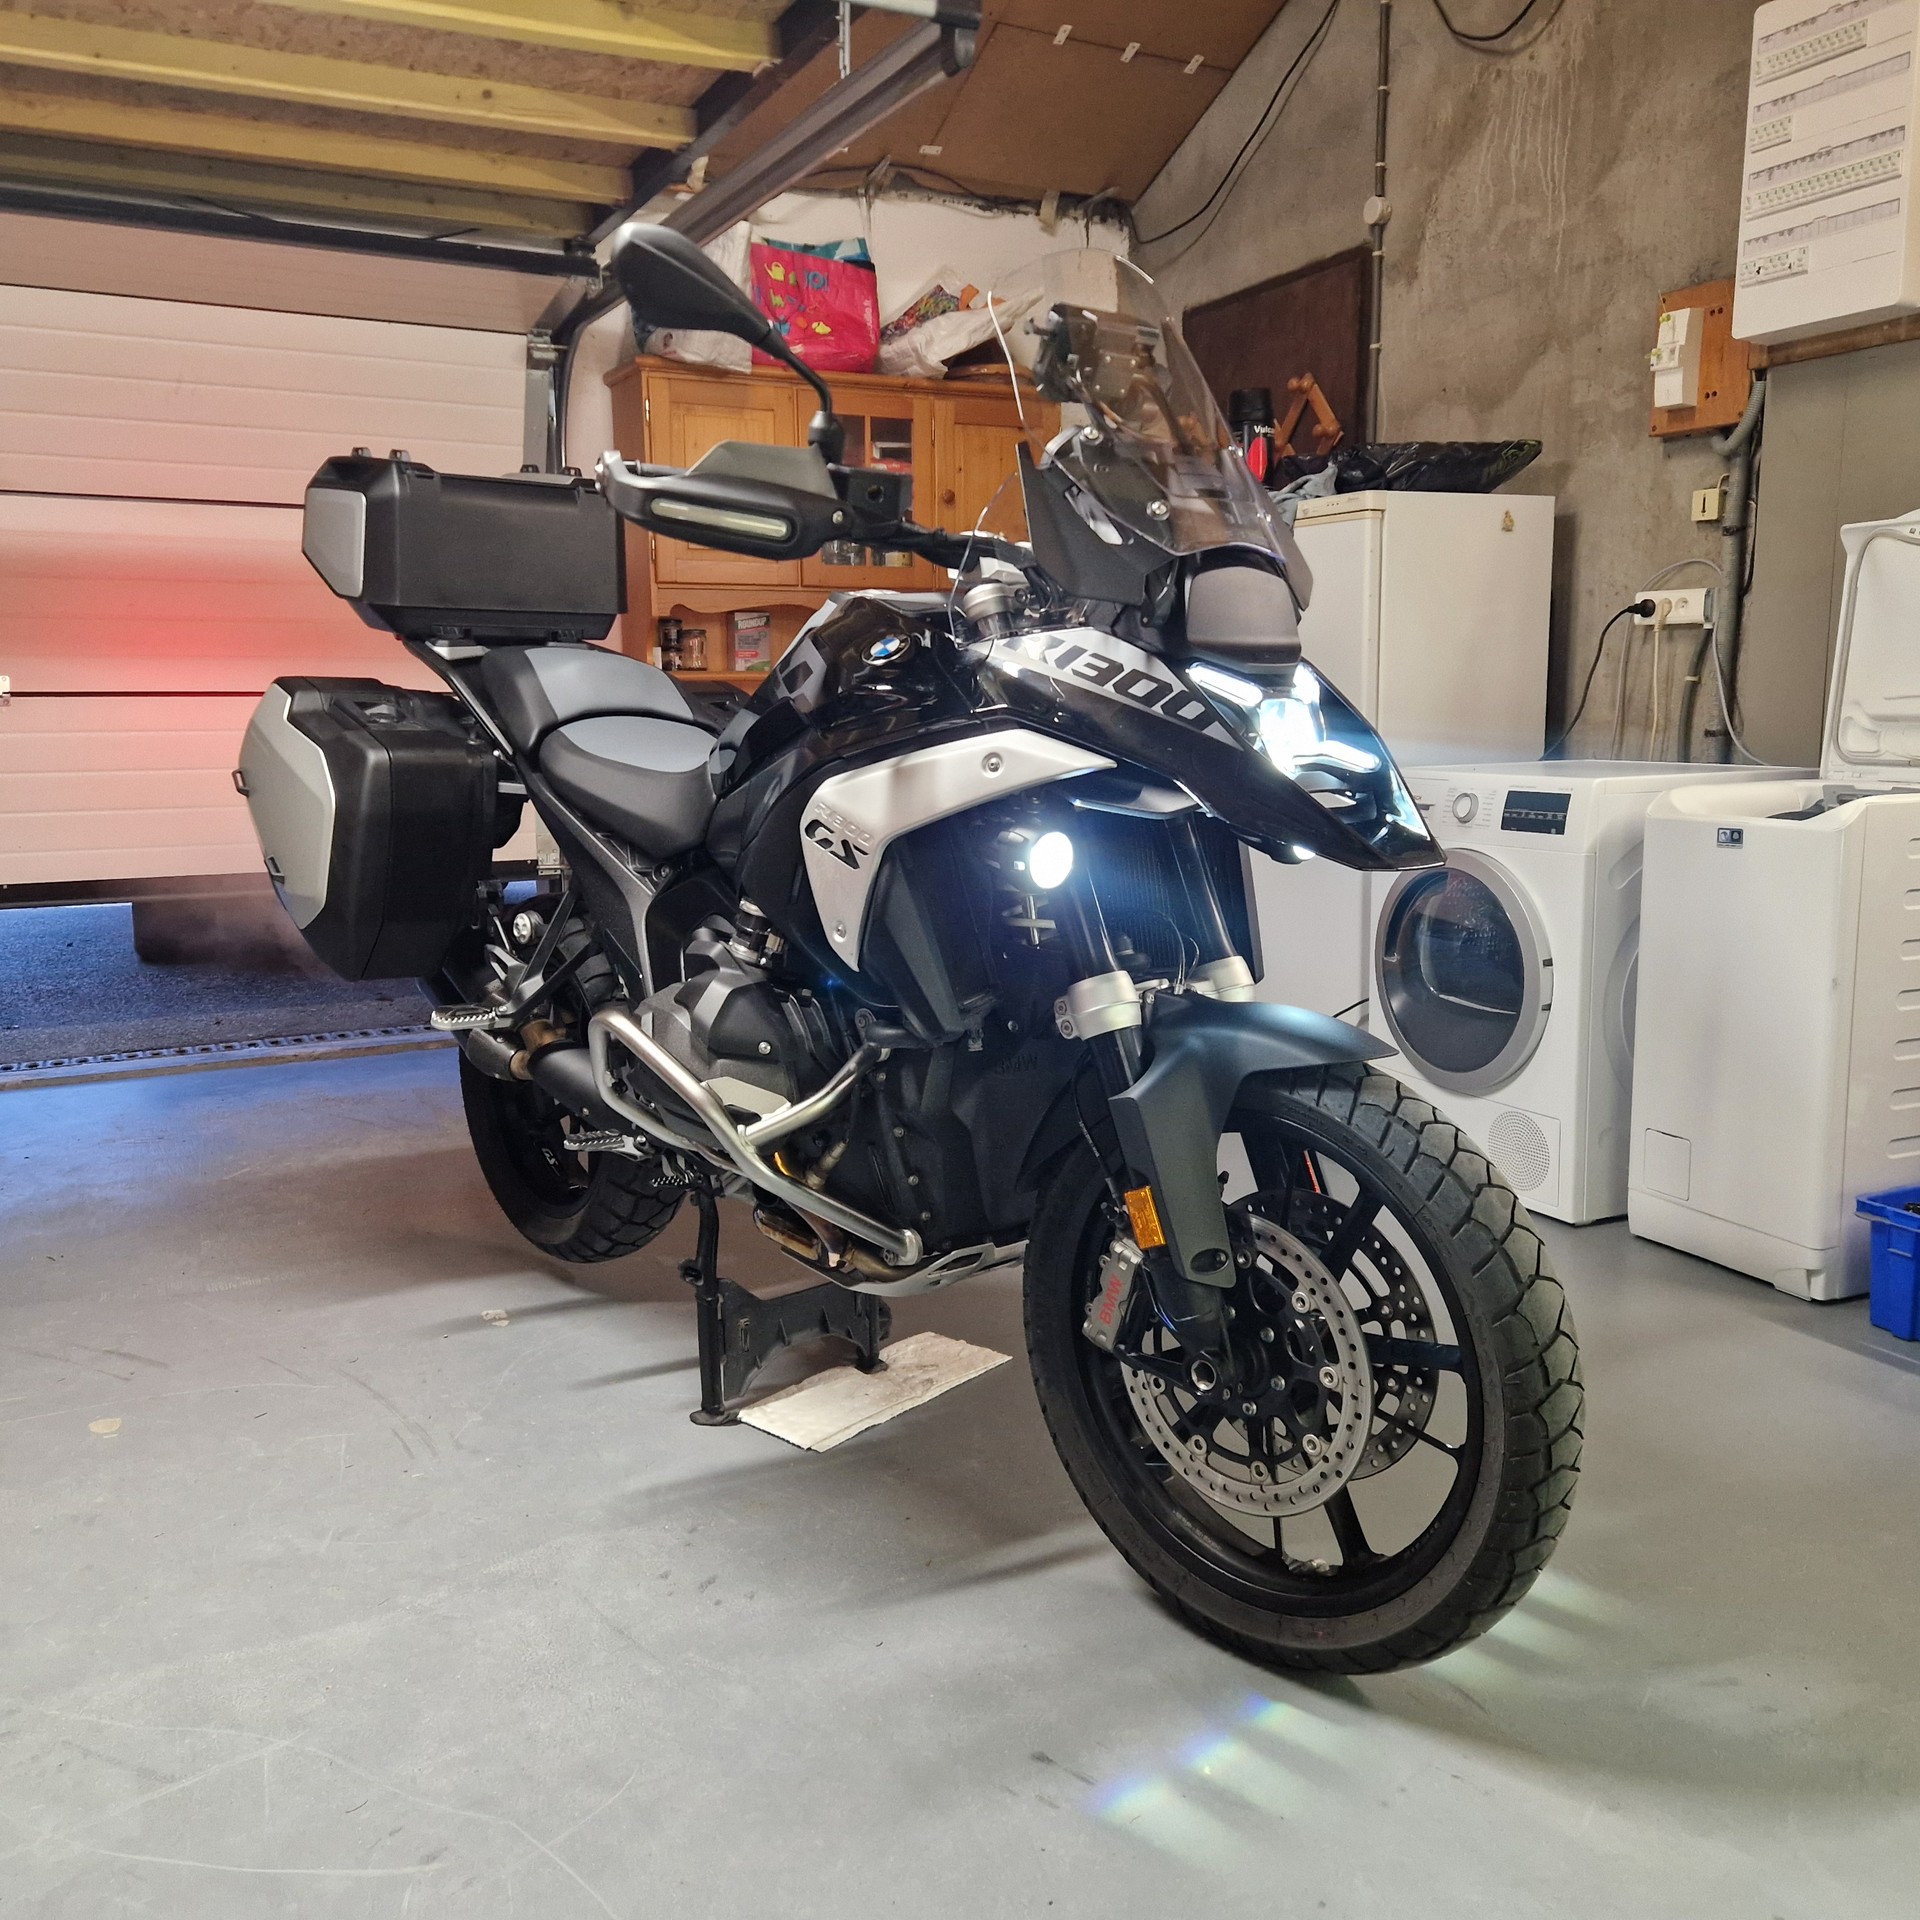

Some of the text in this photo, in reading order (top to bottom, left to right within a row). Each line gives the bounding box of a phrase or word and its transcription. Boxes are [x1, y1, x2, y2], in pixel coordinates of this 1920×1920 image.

[737, 616, 767, 630] ROUNDUP
[804, 818, 869, 870] GS
[1099, 1273, 1122, 1325] BMW
